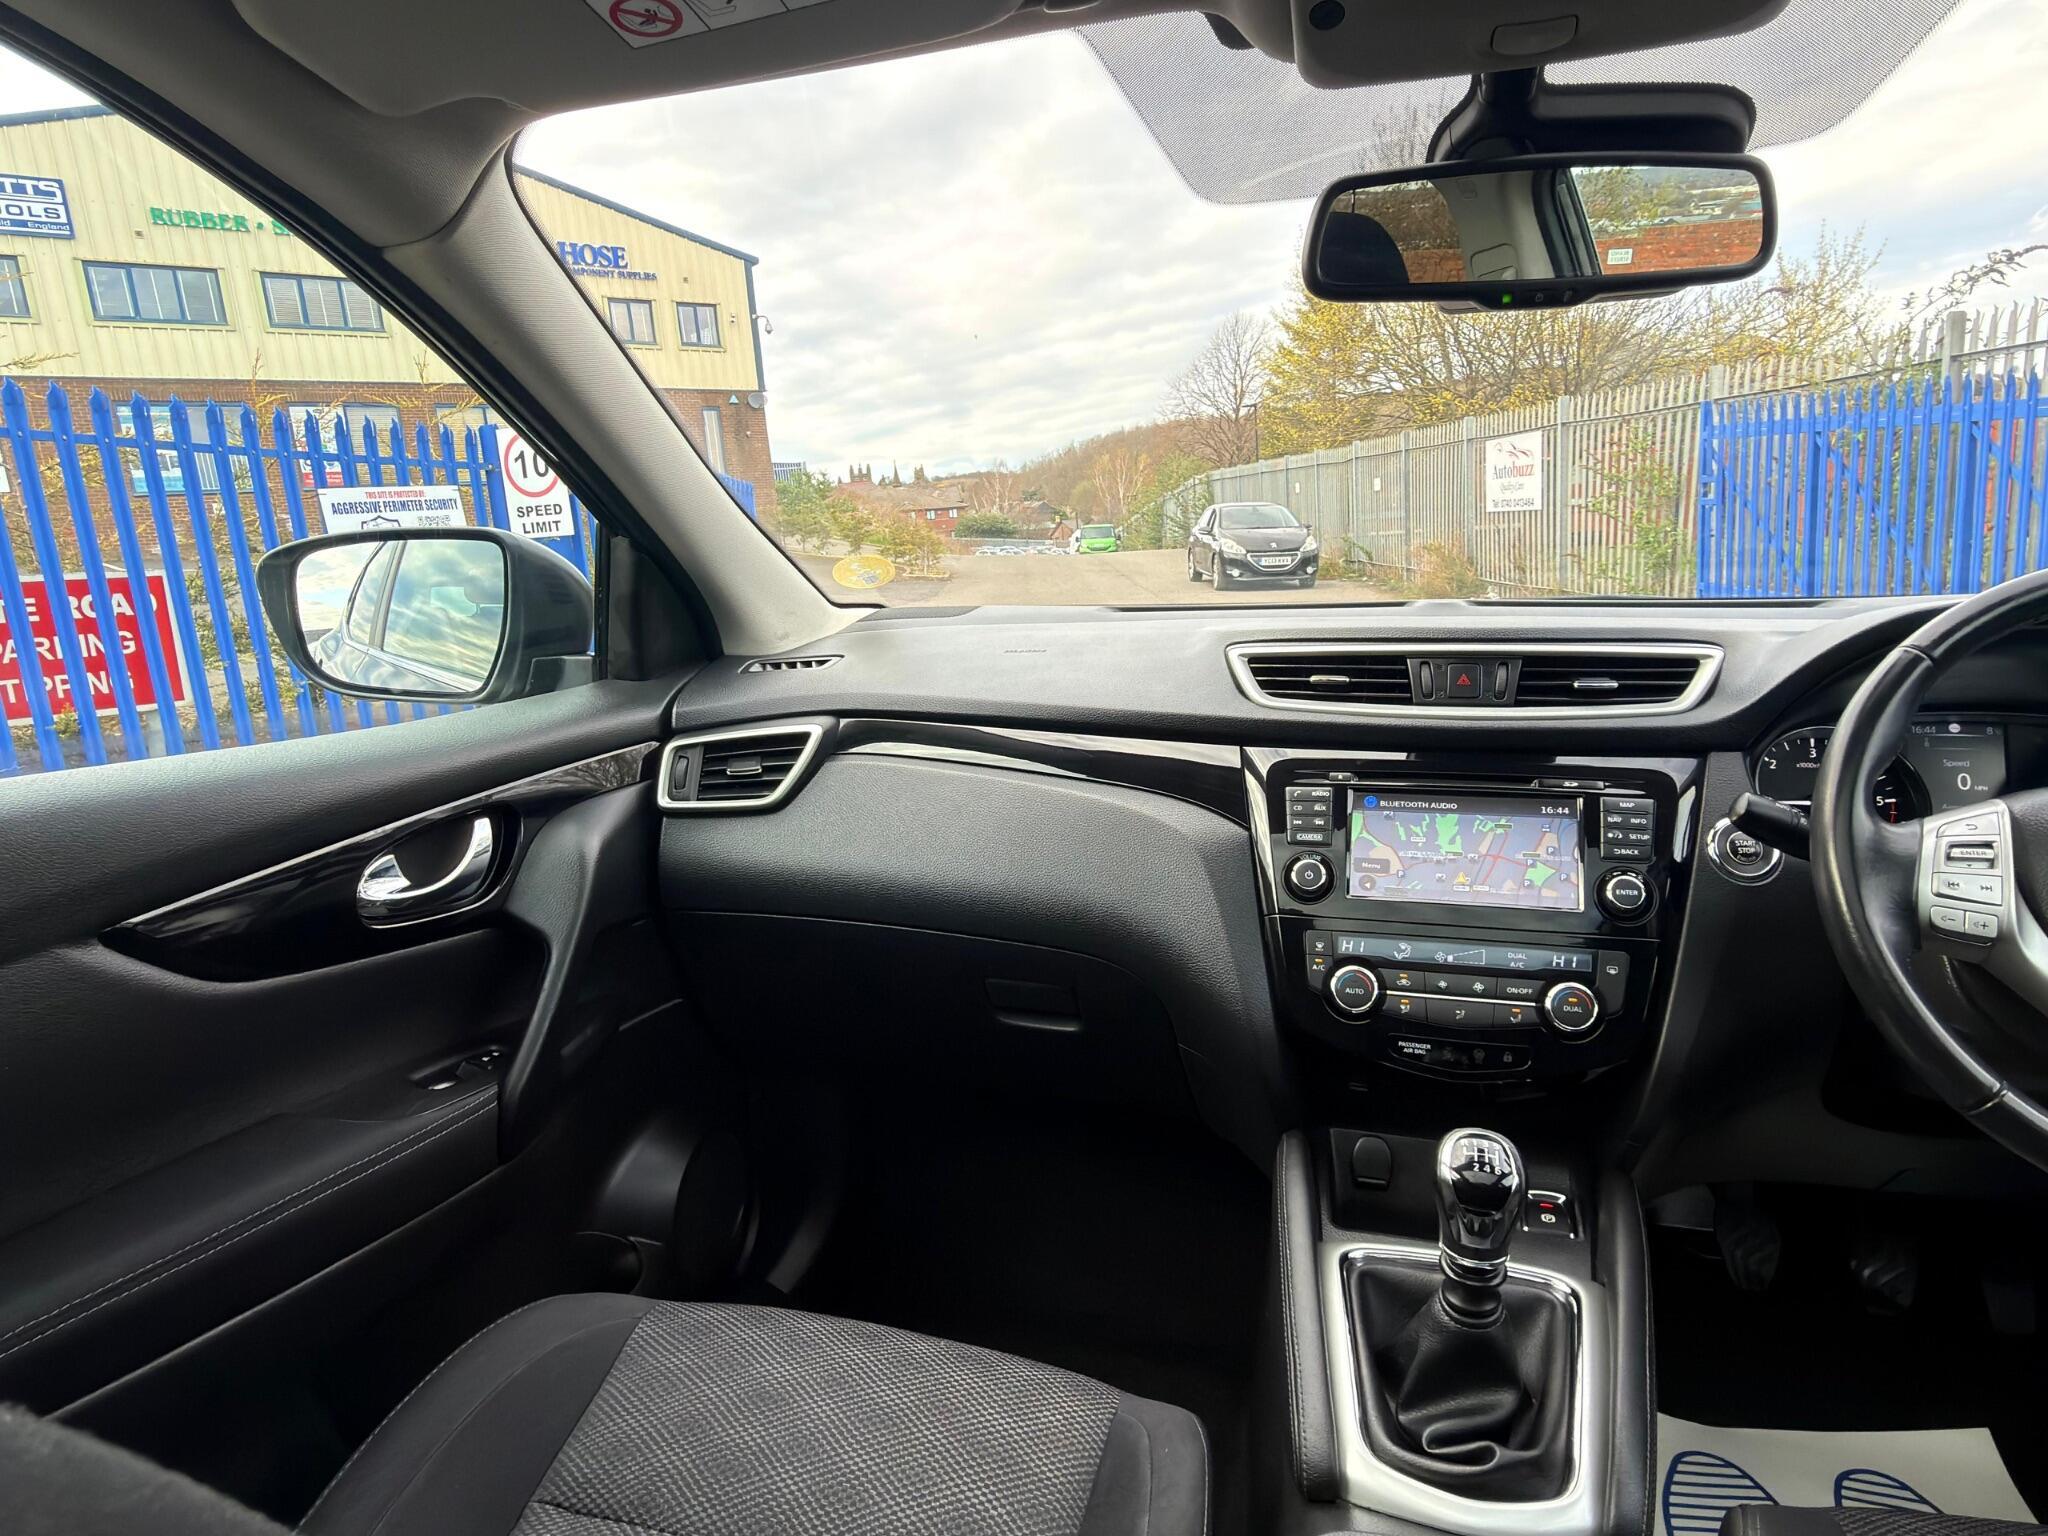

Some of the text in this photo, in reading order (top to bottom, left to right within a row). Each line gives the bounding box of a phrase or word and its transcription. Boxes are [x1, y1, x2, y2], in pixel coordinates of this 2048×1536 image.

[0, 204, 61, 219] OLS
[150, 207, 250, 232] RUBBER
[27, 221, 70, 231] England
[557, 241, 628, 268] HOSE
[617, 270, 657, 281] SUPPLIES
[514, 450, 549, 478] 10
[1492, 461, 1535, 479] Autobuzz
[365, 491, 377, 499] THIS
[377, 491, 388, 499] SITE
[393, 490, 417, 498] PROTECTED
[331, 498, 458, 515] AGGRESSIVE PERIMETER SECURITY
[517, 503, 562, 518] SPEED
[522, 520, 561, 534] LIMIT
[1911, 725, 1936, 734] 16:44
[1809, 748, 1816, 758] 3
[1769, 760, 1776, 769] 2
[1943, 759, 1970, 767] Speed
[1957, 773, 1971, 790] 0
[1380, 800, 1458, 810] BLUETOOTH AUDIO
[1876, 796, 1884, 806] 5
[1540, 806, 1570, 815] 16:44
[1615, 888, 1639, 896] ENTER
[1507, 952, 1528, 960] DUAL
[1510, 961, 1525, 969] A/C
[1344, 987, 1365, 995] AUTO
[1563, 1005, 1583, 1013] DUAL
[1398, 1041, 1432, 1050] PASSENGER
[1473, 1163, 1480, 1172] 2
[1495, 1167, 1502, 1175] 6
